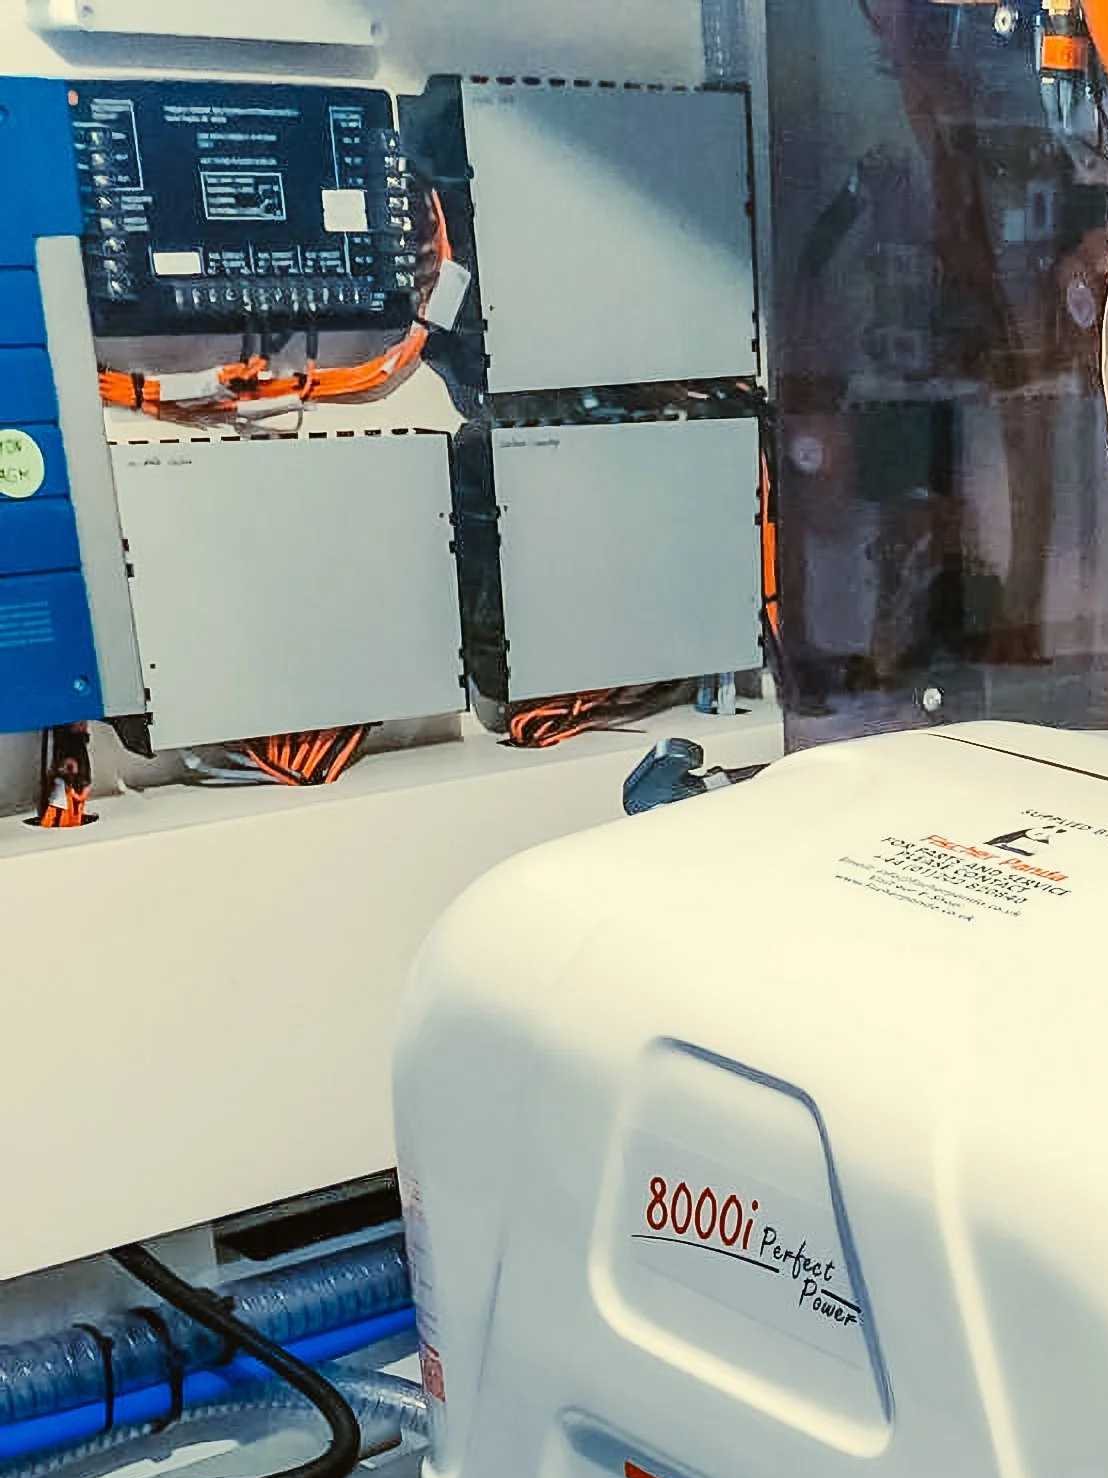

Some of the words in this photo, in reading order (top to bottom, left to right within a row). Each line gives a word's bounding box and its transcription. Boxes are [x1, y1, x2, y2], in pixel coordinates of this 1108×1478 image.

[919, 834, 1001, 860] Fischer
[999, 857, 1069, 882] Panda
[953, 868, 1030, 893] CONTACT
[964, 862, 1002, 876] AND
[646, 1176, 759, 1250] 8000i
[760, 1226, 835, 1280] Perfect
[799, 1279, 858, 1326] Power
